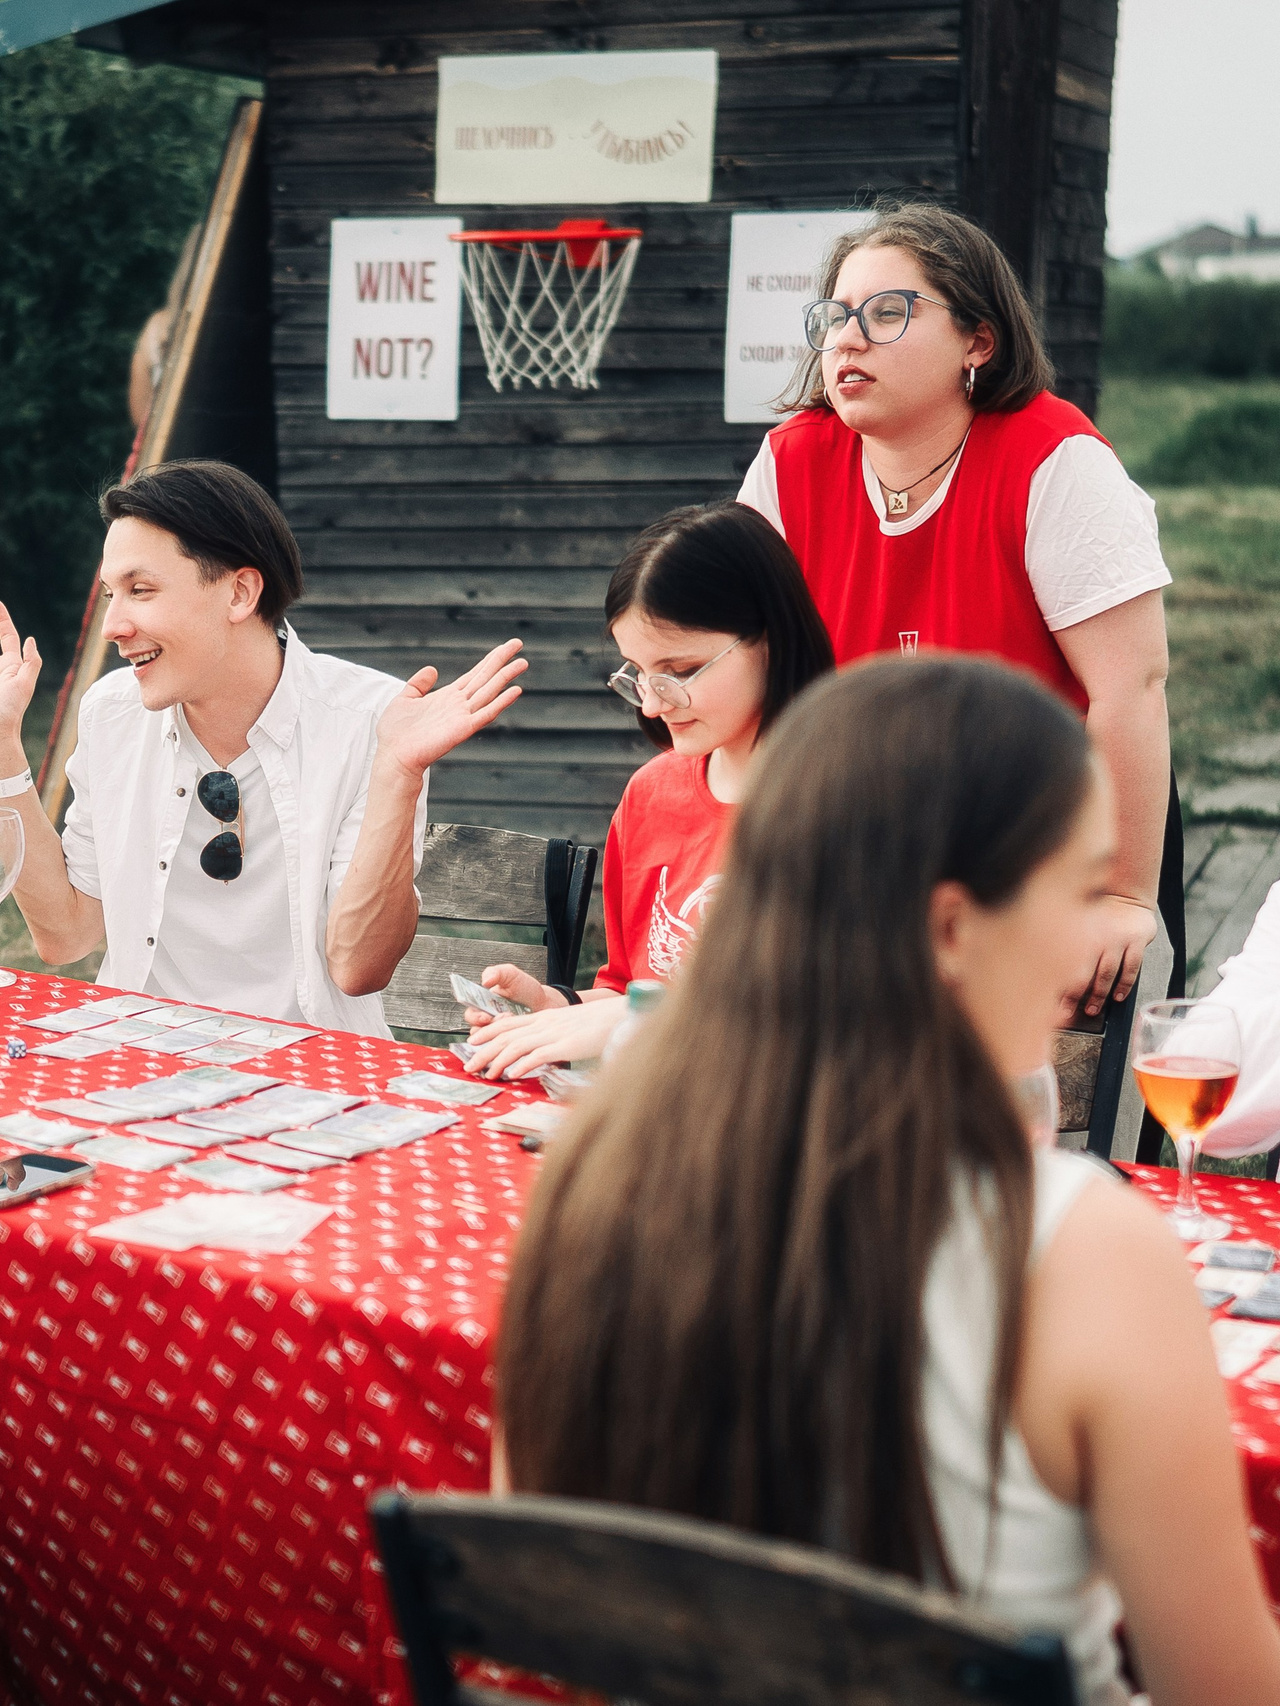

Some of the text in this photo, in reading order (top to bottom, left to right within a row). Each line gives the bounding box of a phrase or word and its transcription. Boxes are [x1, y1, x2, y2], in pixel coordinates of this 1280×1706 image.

[354, 260, 436, 303] WINE
[746, 275, 811, 293] НЕ СХОДИ
[352, 337, 434, 379] NOT?
[740, 345, 784, 363] СХОДИ
